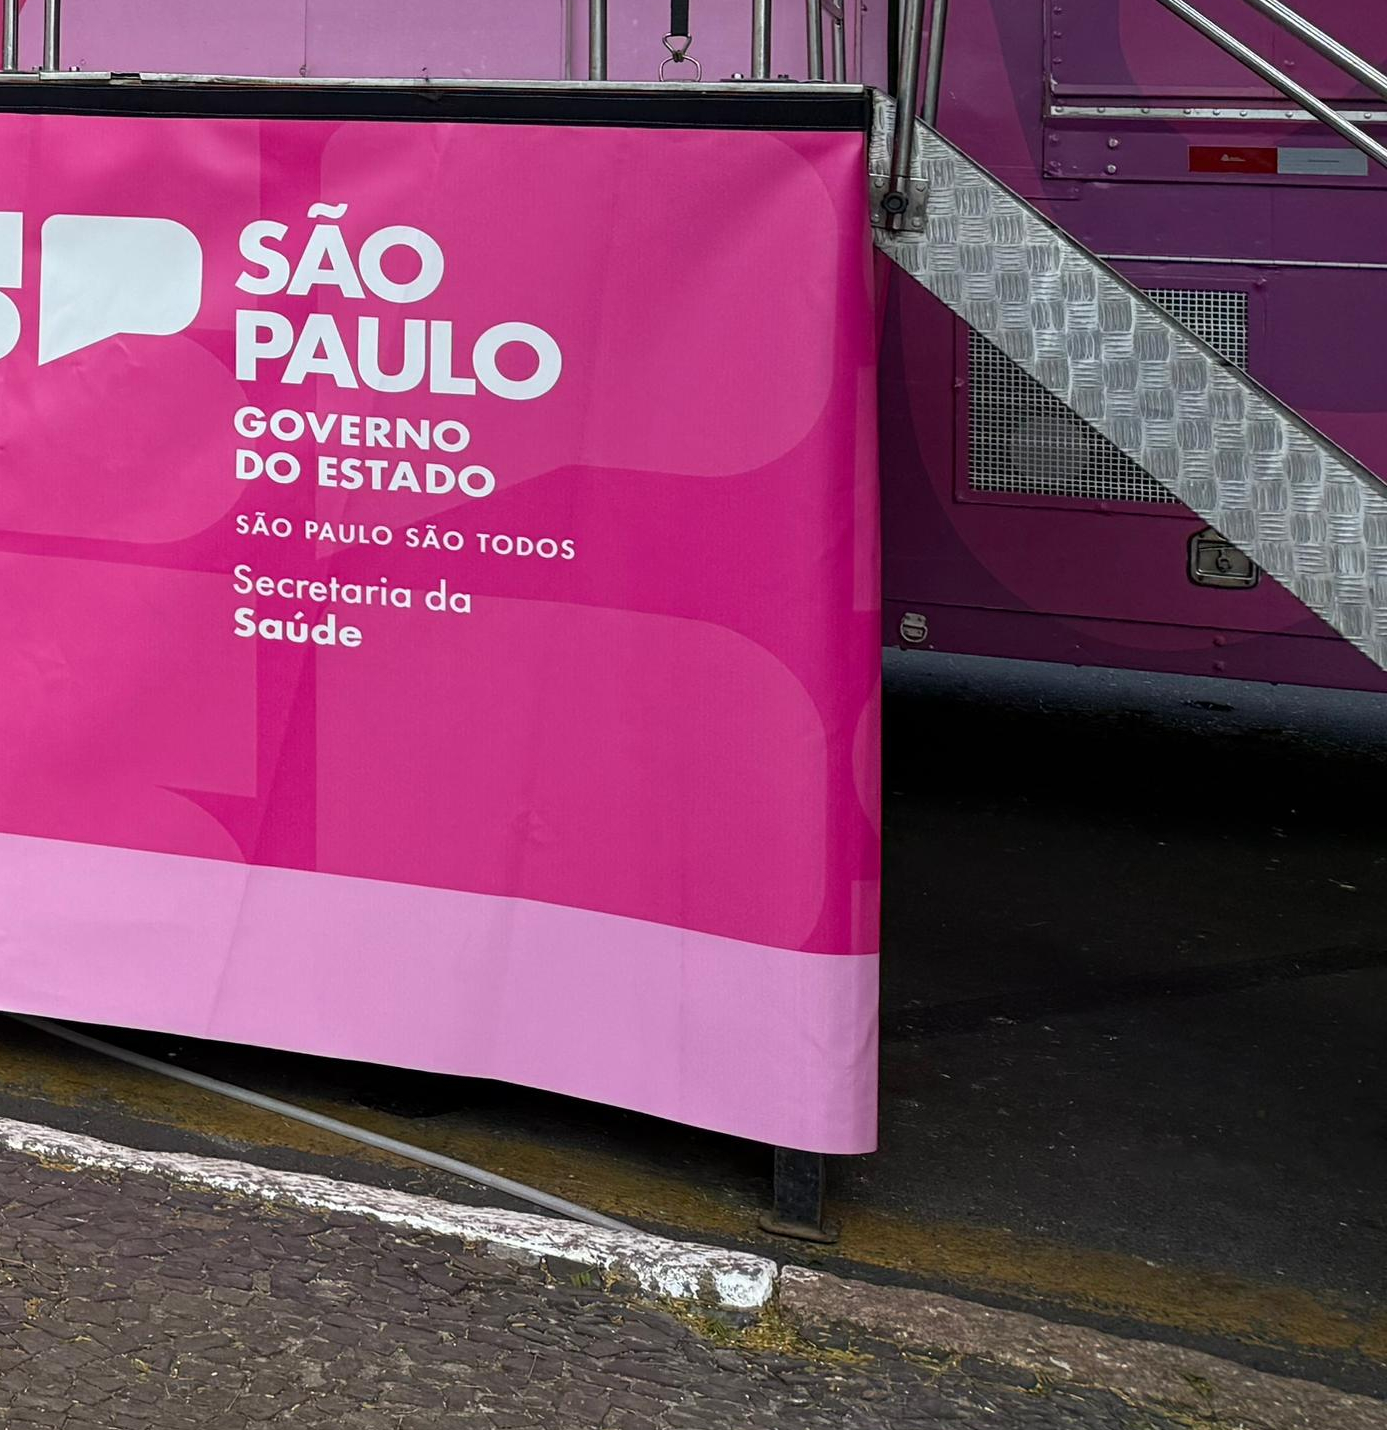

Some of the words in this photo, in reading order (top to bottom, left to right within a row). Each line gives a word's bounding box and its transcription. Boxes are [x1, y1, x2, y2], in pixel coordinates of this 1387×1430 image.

[234, 202, 444, 304] SÃO
[234, 309, 562, 400] PAULO
[233, 406, 470, 453] GOVERNO
[235, 449, 300, 484] DO
[318, 456, 496, 498] ESTADO
[235, 511, 292, 538] SÃO
[305, 520, 393, 546] PAULO
[404, 523, 465, 551] SÃO
[476, 532, 576, 560] TODOS
[233, 565, 411, 609] Secretaria
[425, 579, 471, 614] da
[233, 607, 363, 647] Saúde
